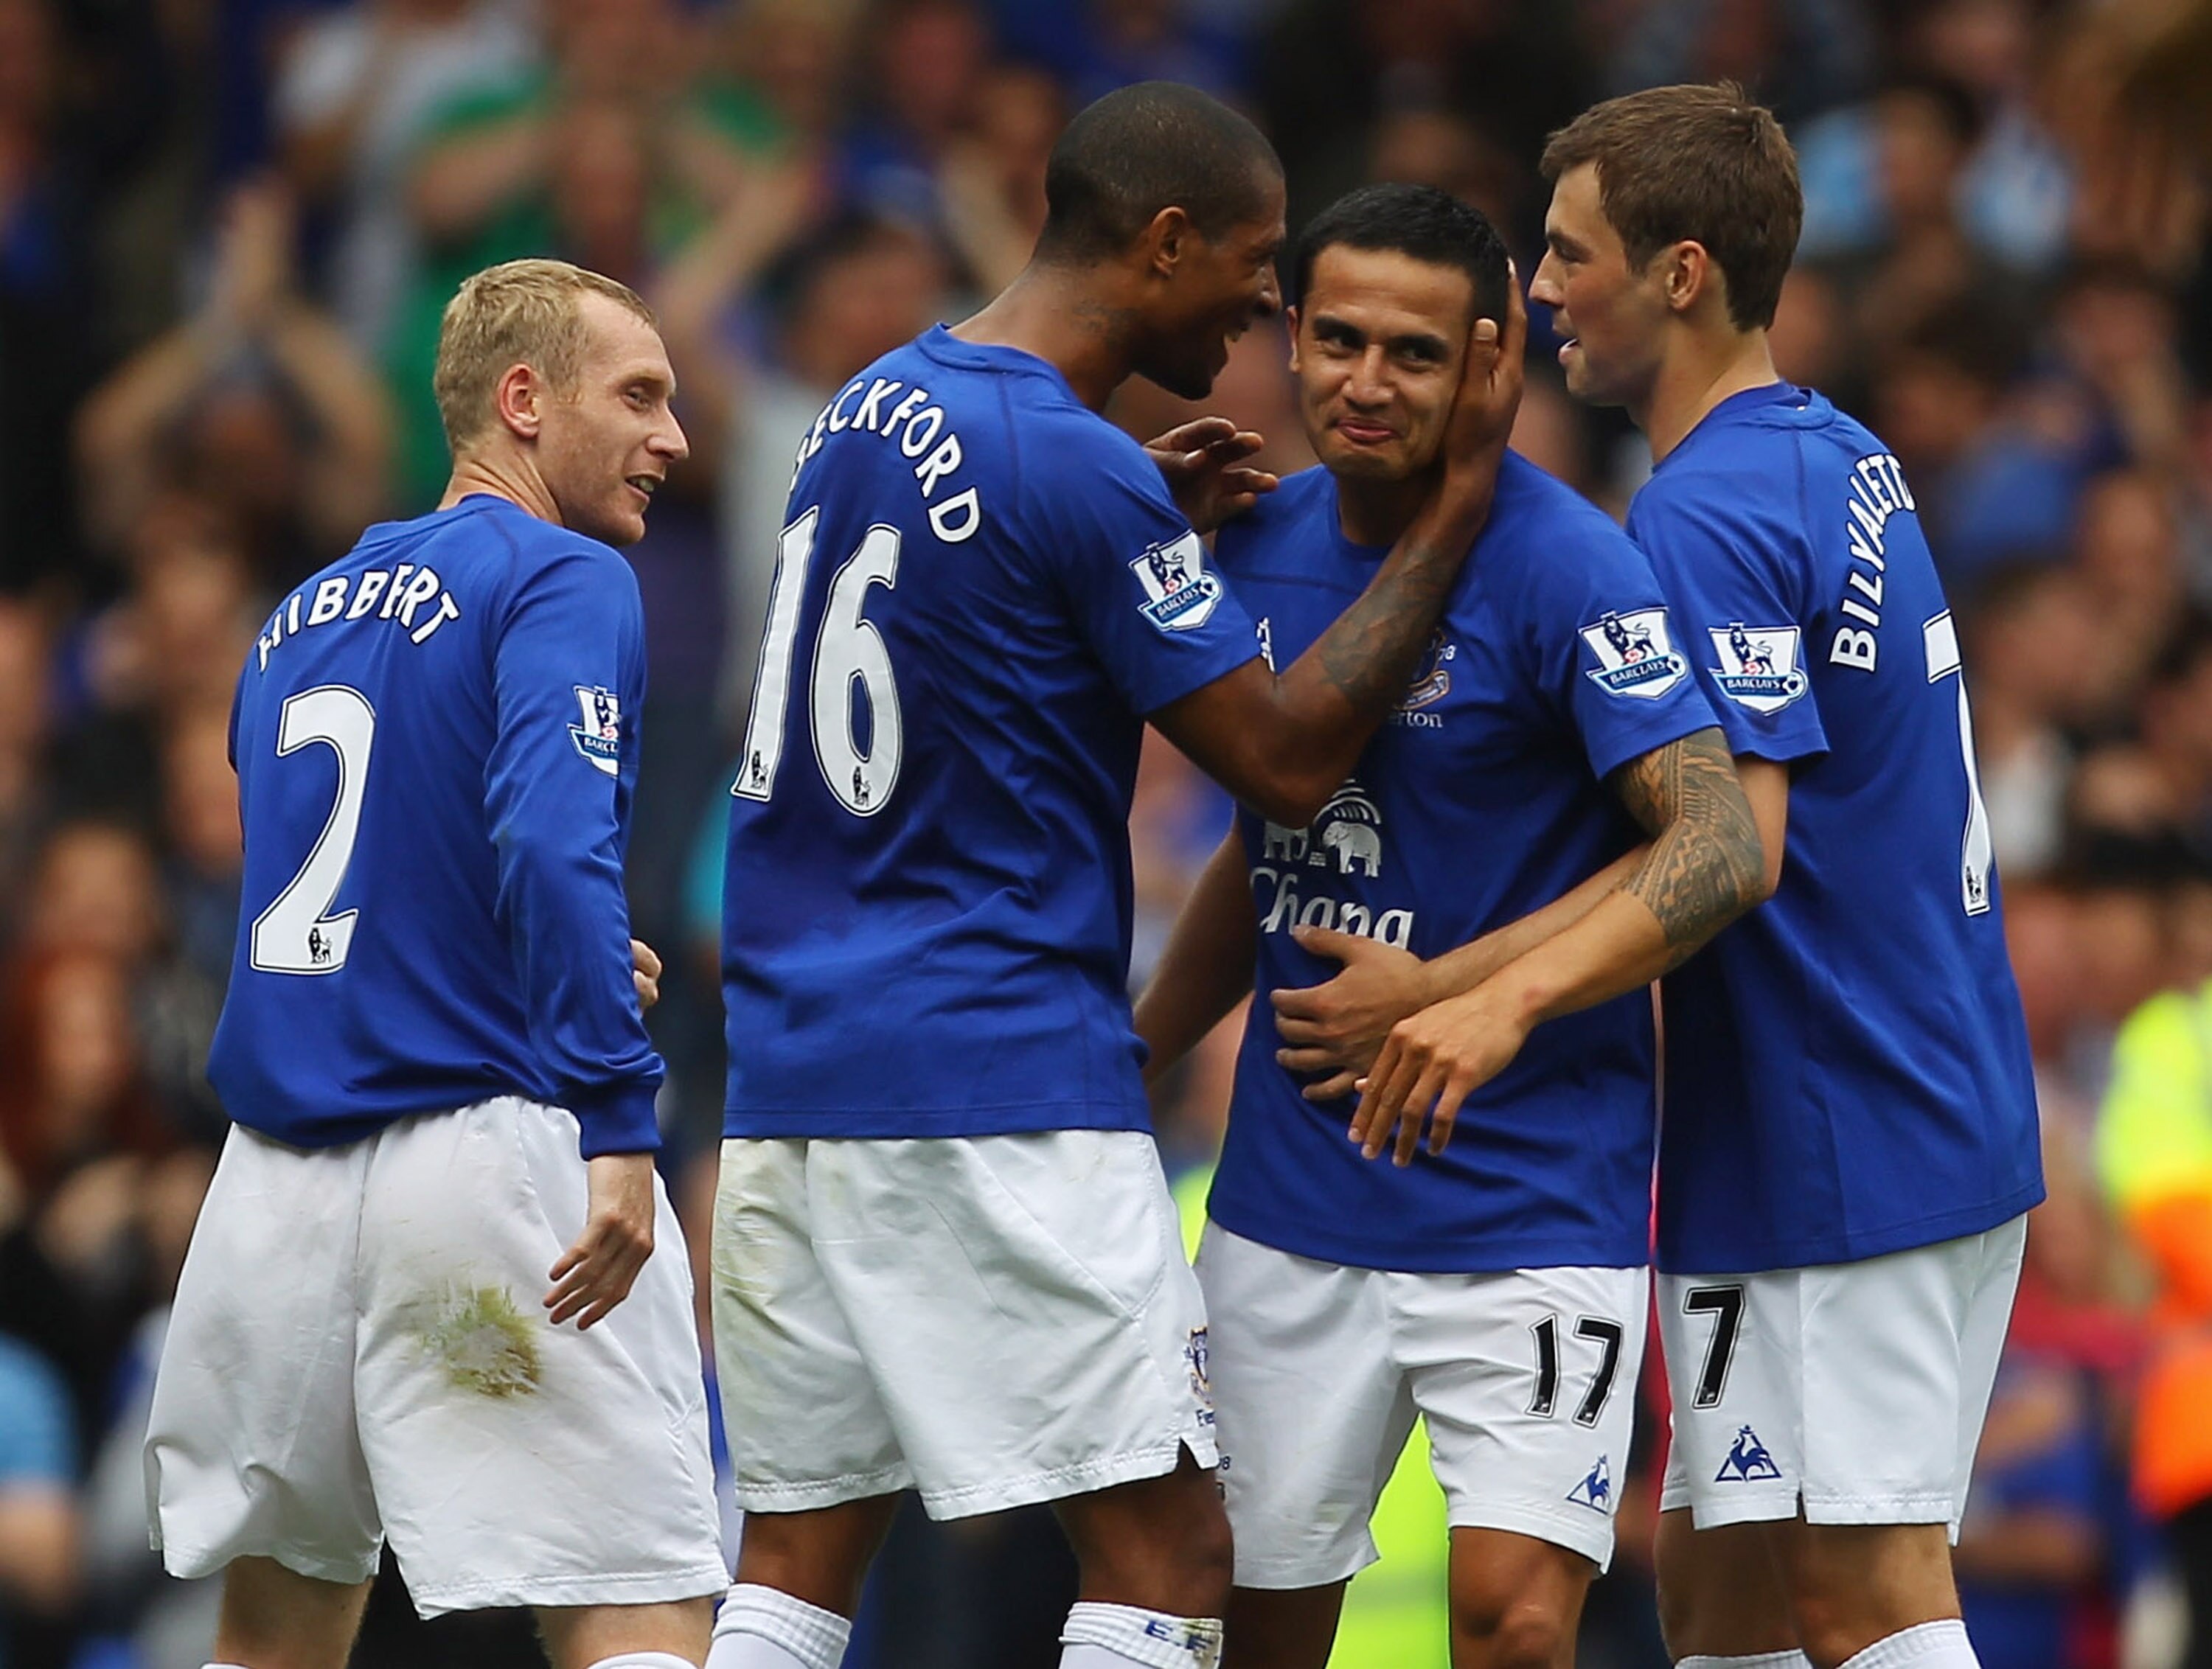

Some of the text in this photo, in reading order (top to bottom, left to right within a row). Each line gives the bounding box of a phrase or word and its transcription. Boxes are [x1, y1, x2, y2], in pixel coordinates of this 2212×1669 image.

[257, 563, 460, 672] HIBBERT
[1155, 586, 1201, 618] BARCLAYS
[731, 505, 902, 818] 16
[1609, 659, 1666, 685] BARCLAYS
[1726, 677, 1781, 689] BARCLAYS
[583, 736, 619, 753] BARCL
[1922, 607, 1992, 917] 7
[251, 683, 377, 975] 2
[1524, 1312, 1624, 1429] 17
[1682, 1283, 1746, 1410] 7
